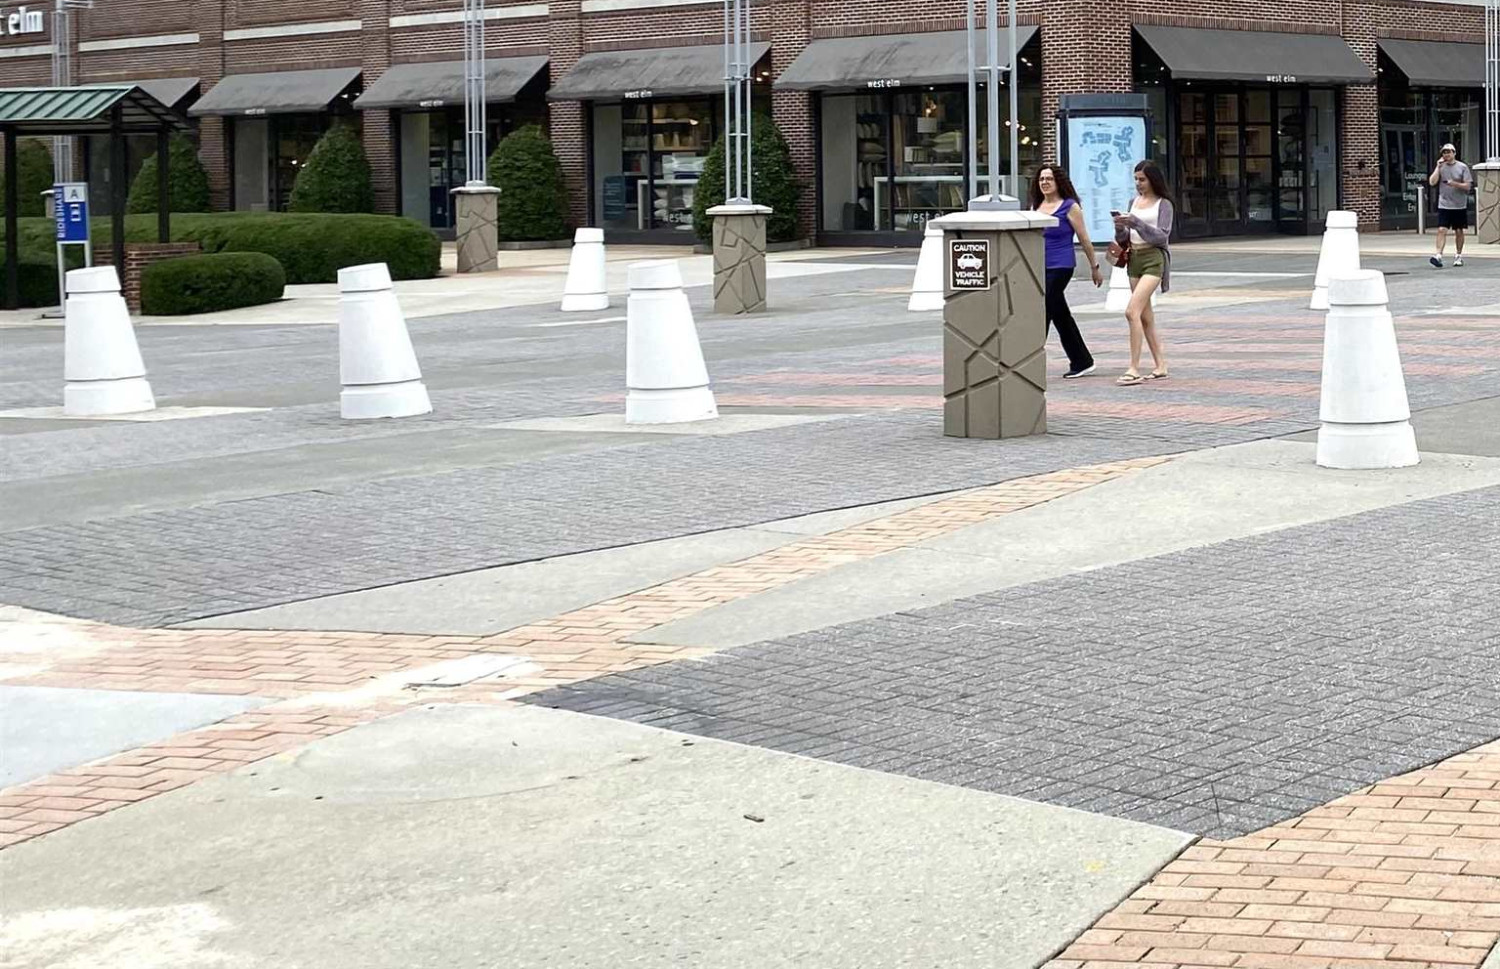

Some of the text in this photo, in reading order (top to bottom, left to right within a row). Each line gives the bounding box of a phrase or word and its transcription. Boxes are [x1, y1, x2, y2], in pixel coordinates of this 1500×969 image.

[8, 6, 43, 35] elm
[867, 79, 885, 88] west
[71, 189, 78, 199] A
[953, 244, 986, 252] CAUTION
[955, 278, 985, 286] TRAFFIC
